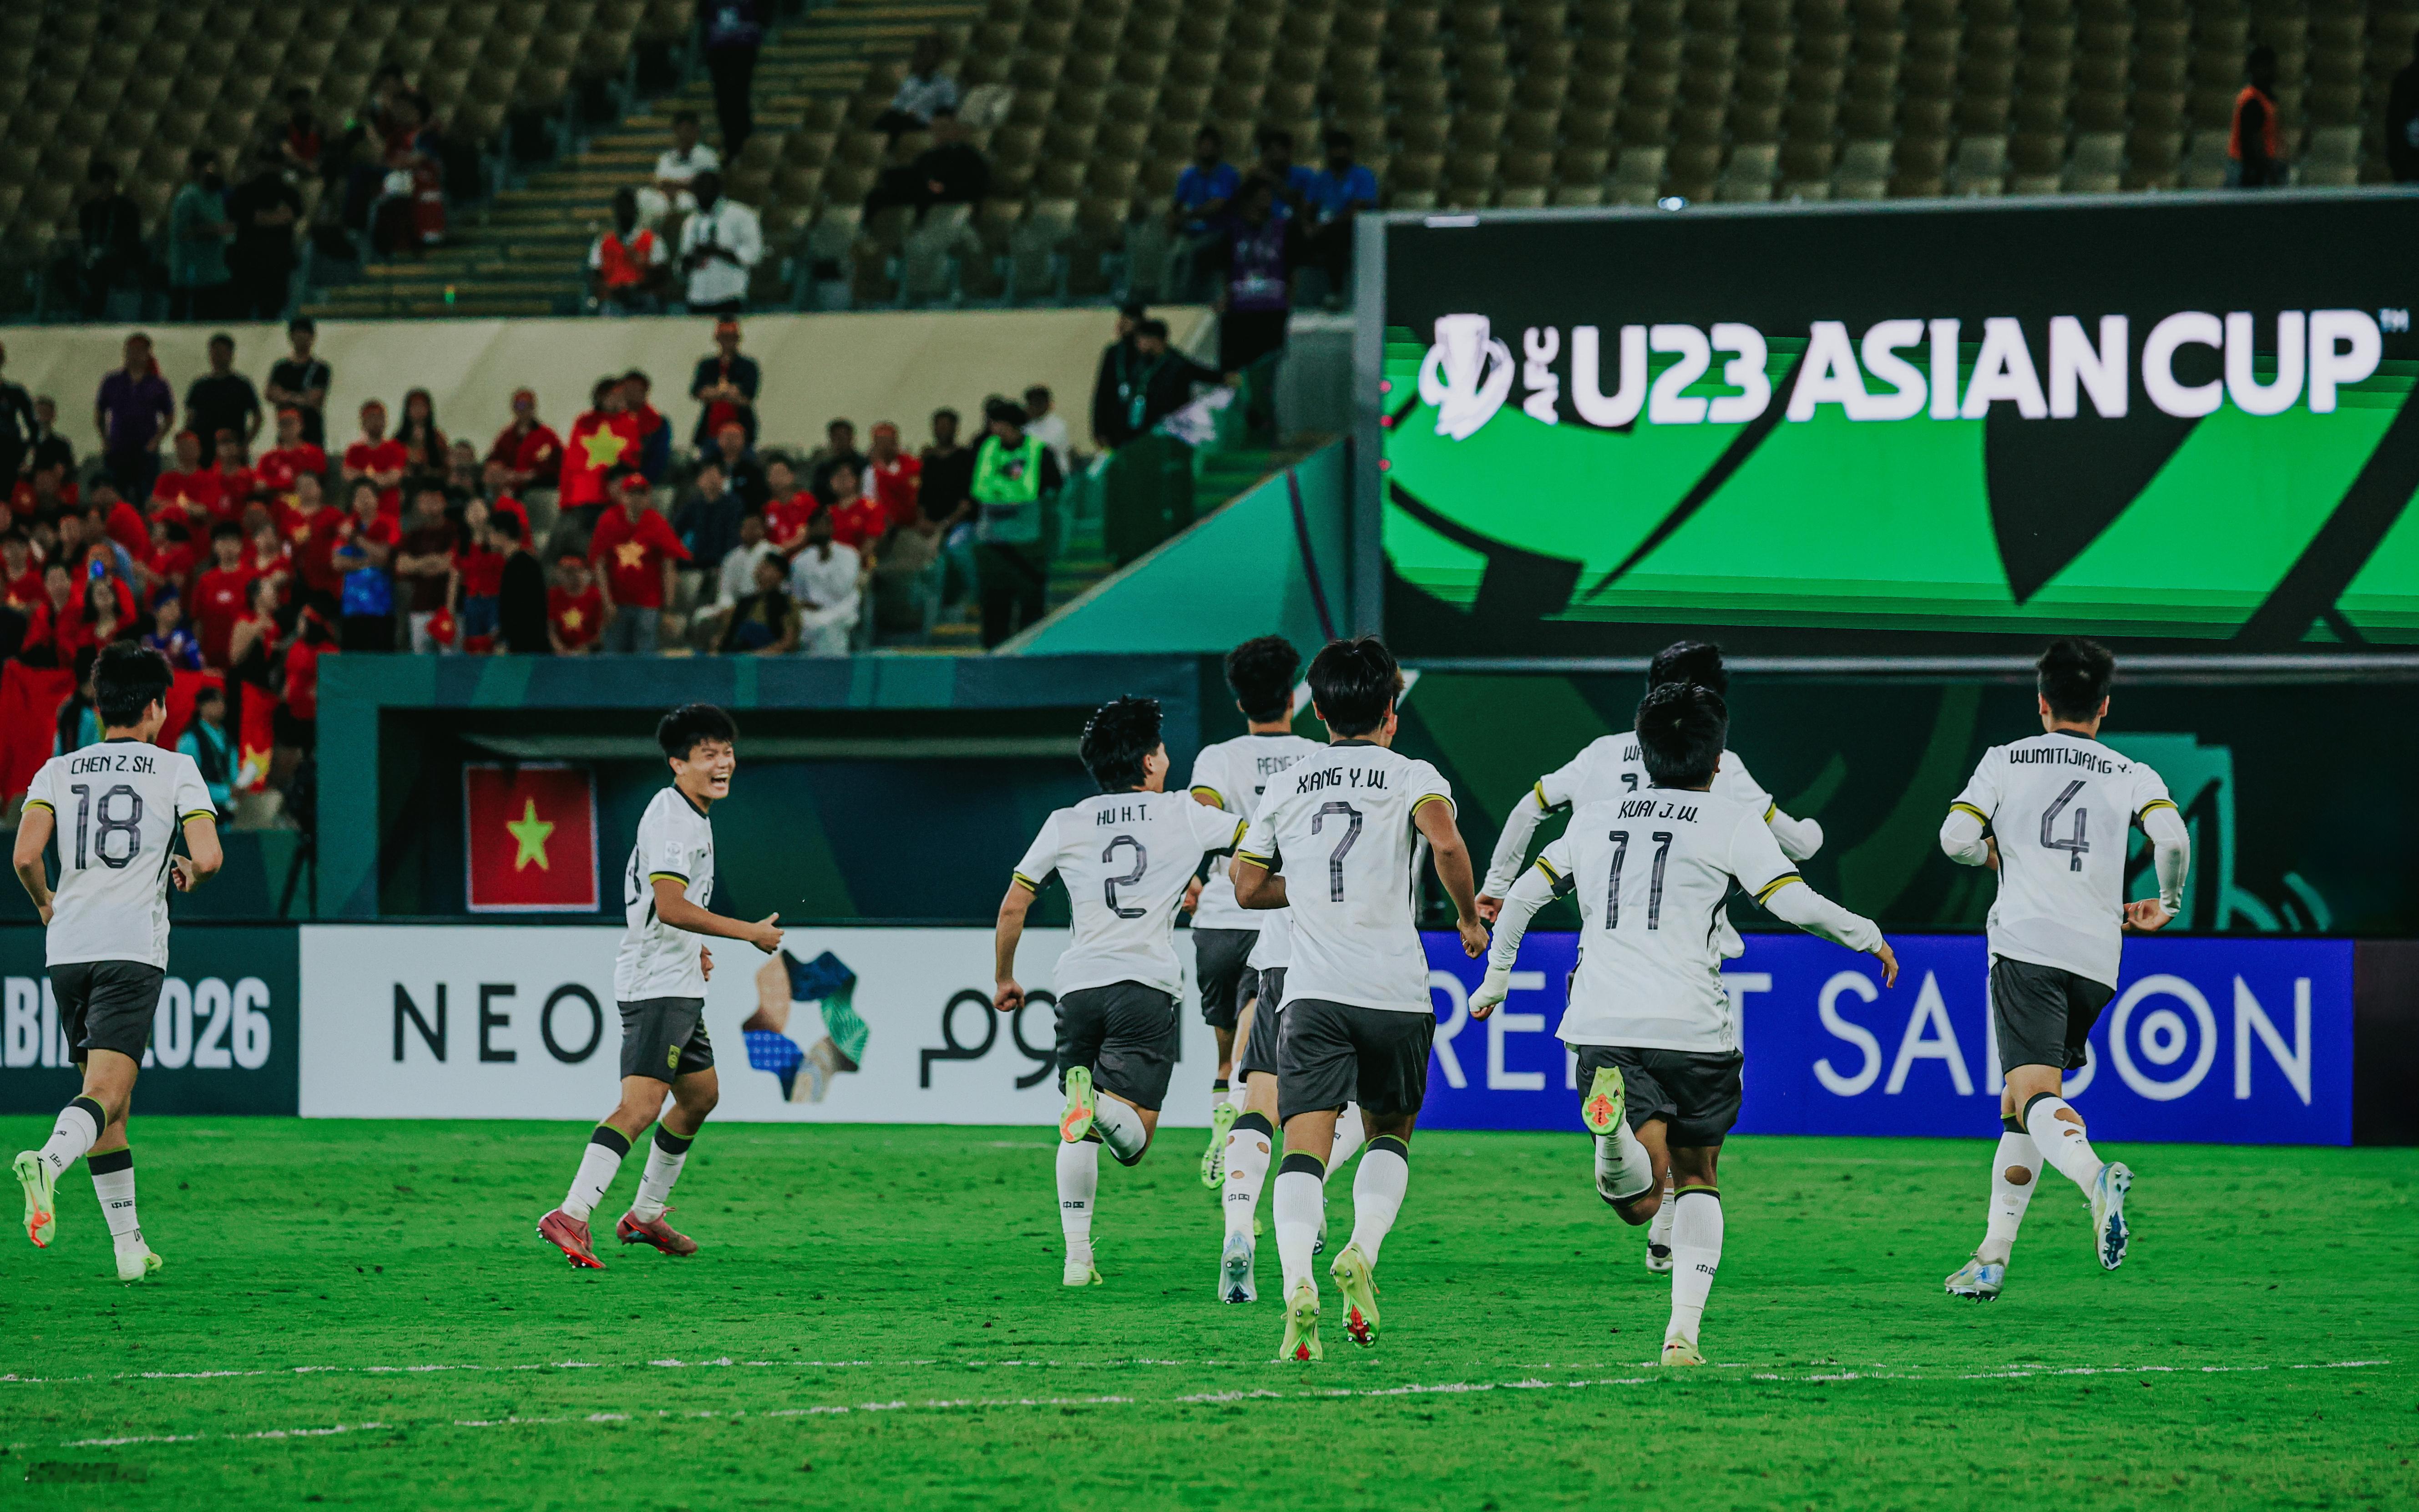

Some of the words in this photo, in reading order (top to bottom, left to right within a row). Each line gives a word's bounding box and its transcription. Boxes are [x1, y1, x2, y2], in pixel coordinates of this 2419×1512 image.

[1523, 324, 1560, 425] AFC
[1571, 323, 1771, 427] U23
[1785, 315, 2128, 423] ASIAN
[2142, 309, 2383, 417] CUP
[71, 755, 111, 774] CHEN
[2009, 747, 2112, 774] WUMITIJIANG
[2117, 764, 2132, 774] Y.
[70, 784, 143, 870] 18
[1096, 808, 1116, 826] HU
[1311, 801, 1363, 902] 7
[1617, 799, 1658, 819] KUAI
[2040, 779, 2090, 872] 4
[1102, 834, 1148, 919] 2
[1605, 830, 1674, 930] 11
[141, 976, 272, 1070] 026
